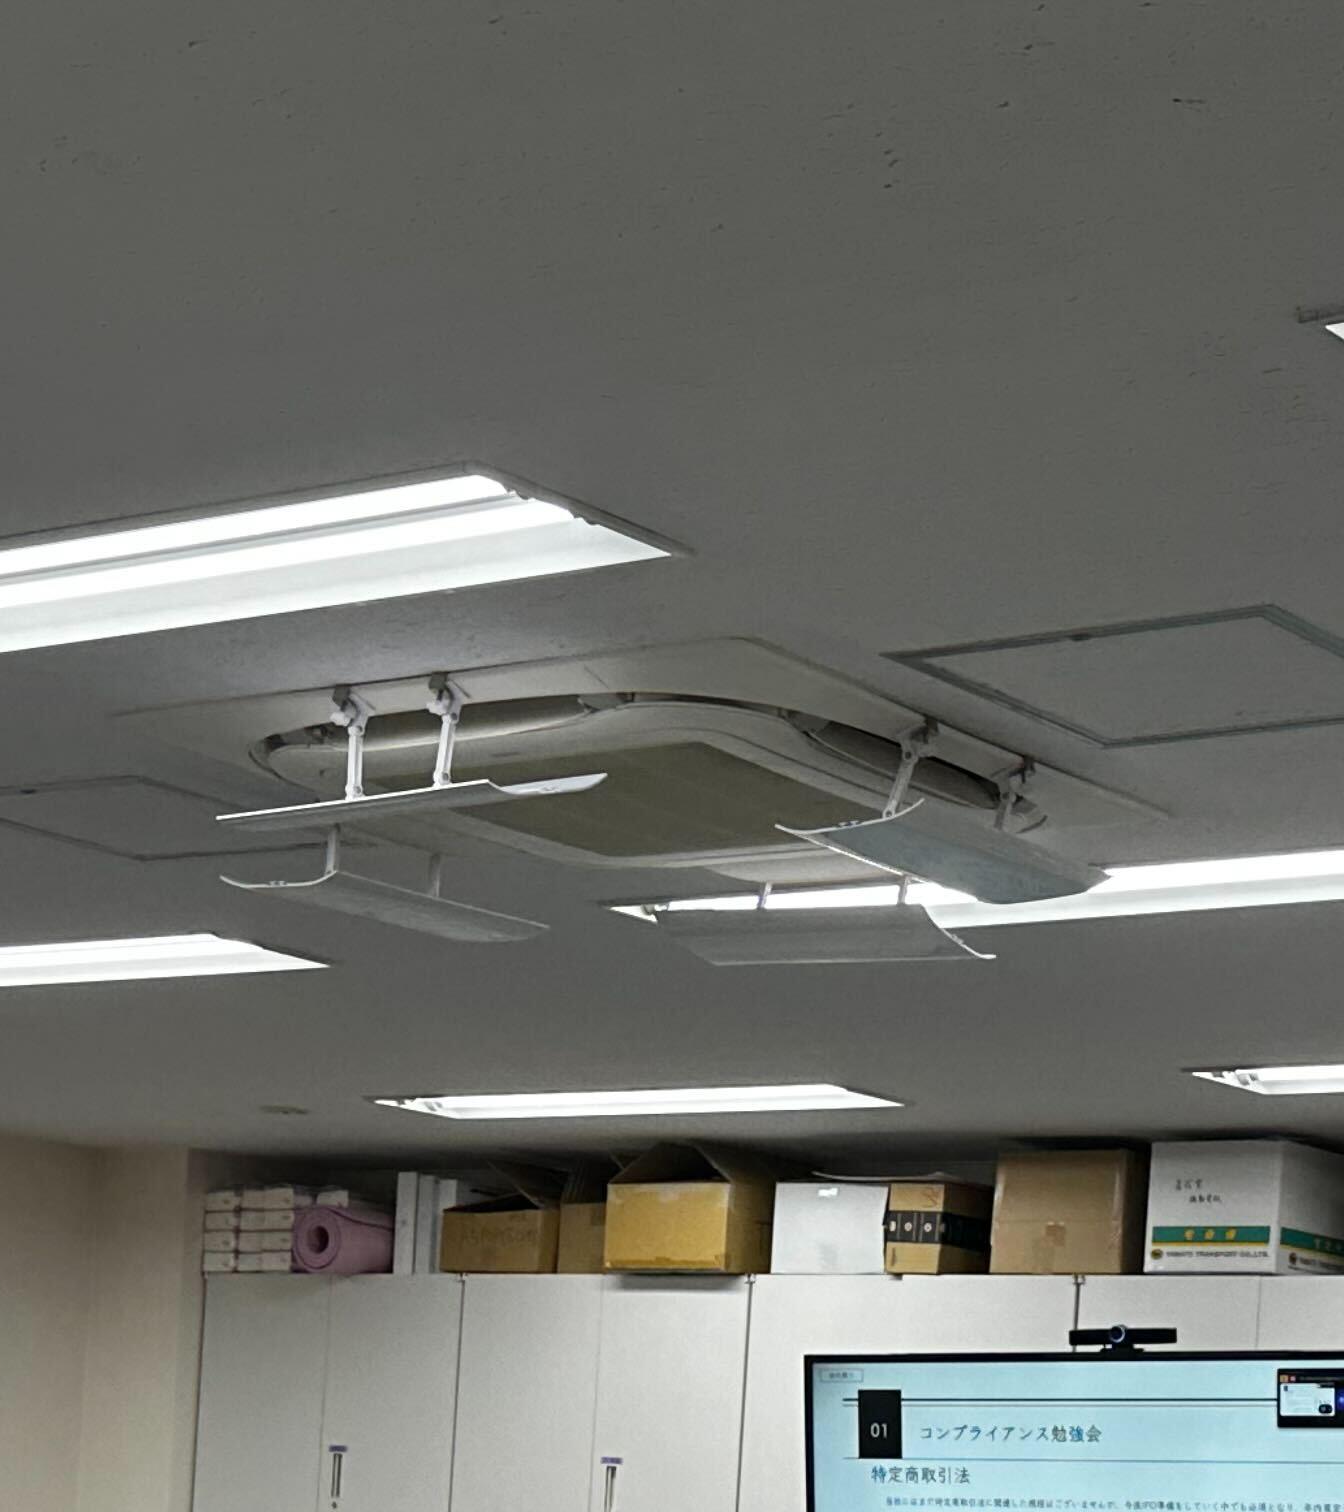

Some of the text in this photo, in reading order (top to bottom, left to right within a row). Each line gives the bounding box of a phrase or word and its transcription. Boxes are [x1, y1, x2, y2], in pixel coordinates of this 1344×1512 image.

[870, 1422, 888, 1438] 01
[919, 1424, 1103, 1443] コンプライアンス勉強会
[870, 1466, 971, 1484] 特定商取引法
